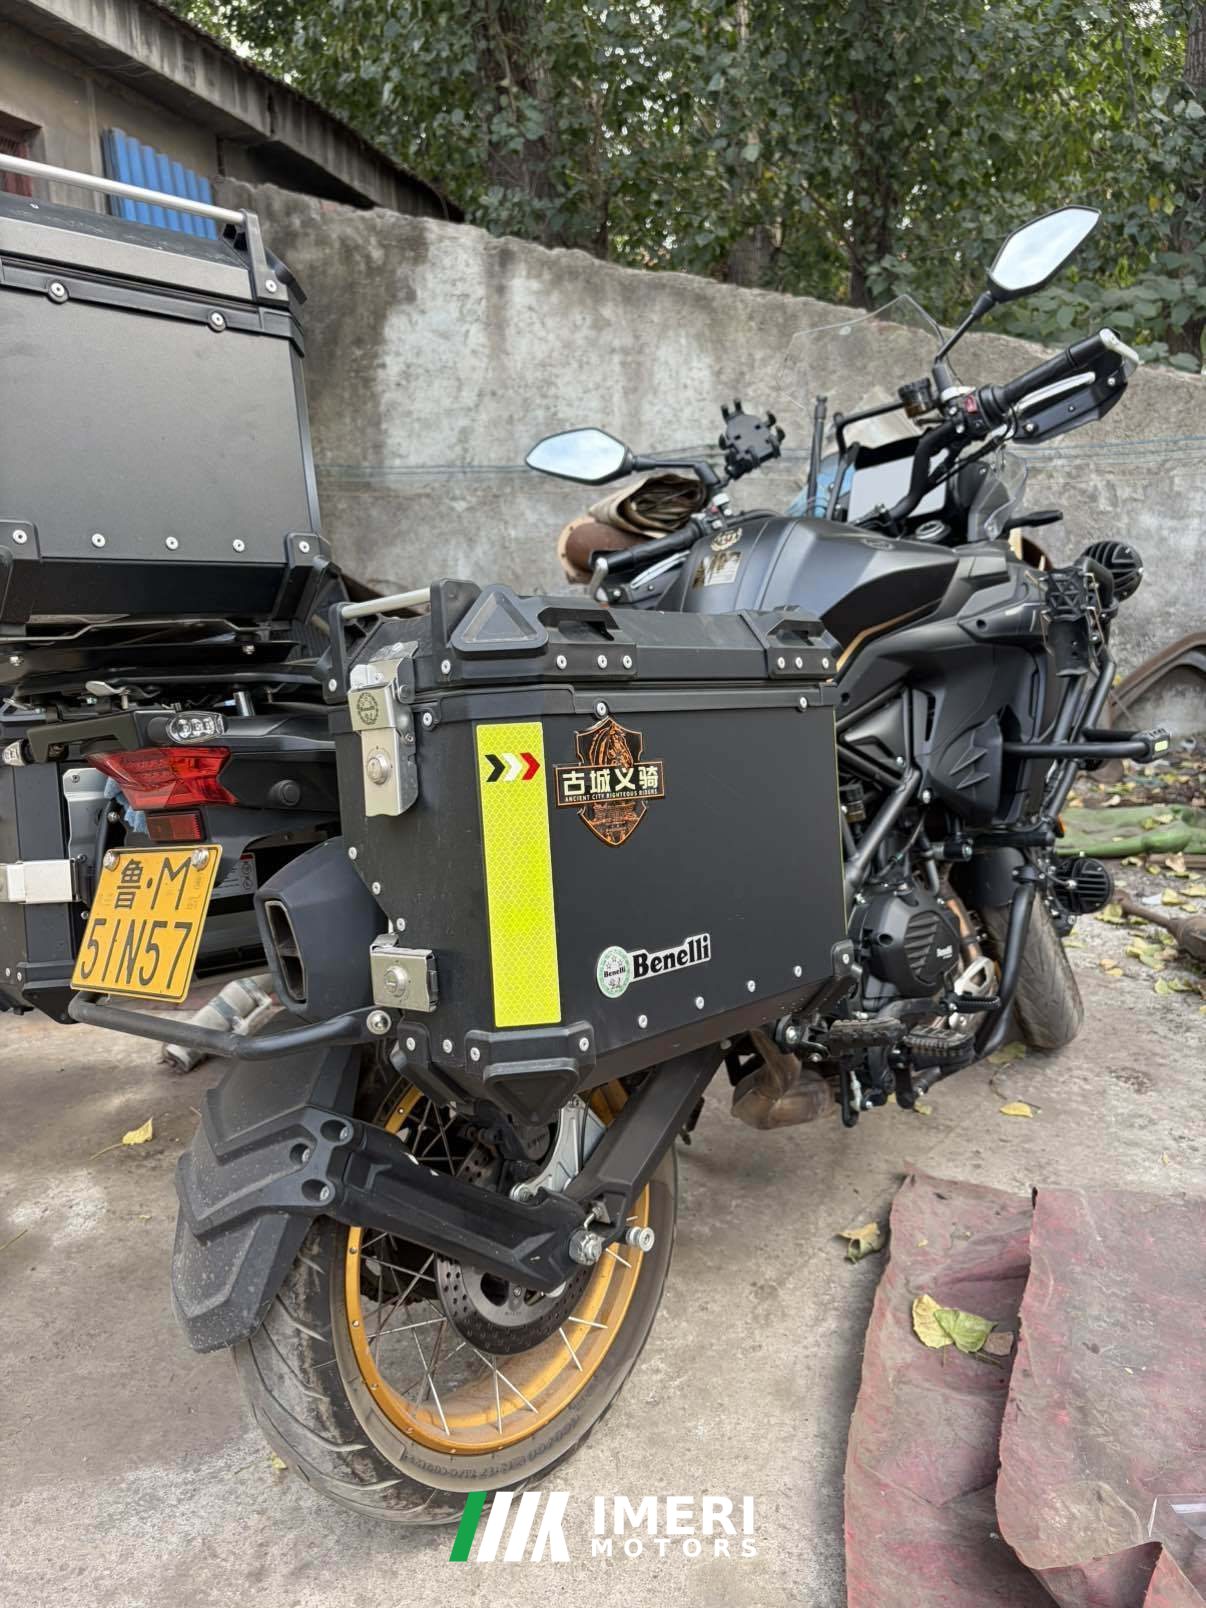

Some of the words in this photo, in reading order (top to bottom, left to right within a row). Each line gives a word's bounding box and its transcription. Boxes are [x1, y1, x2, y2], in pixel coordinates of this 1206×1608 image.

[562, 765, 659, 796] 古城义骑
[565, 794, 590, 802] ANCIENT
[606, 791, 638, 799] RIGHTEOUS
[80, 917, 193, 990] 51N57
[632, 934, 709, 979] Benelli
[604, 965, 626, 978] Benelli
